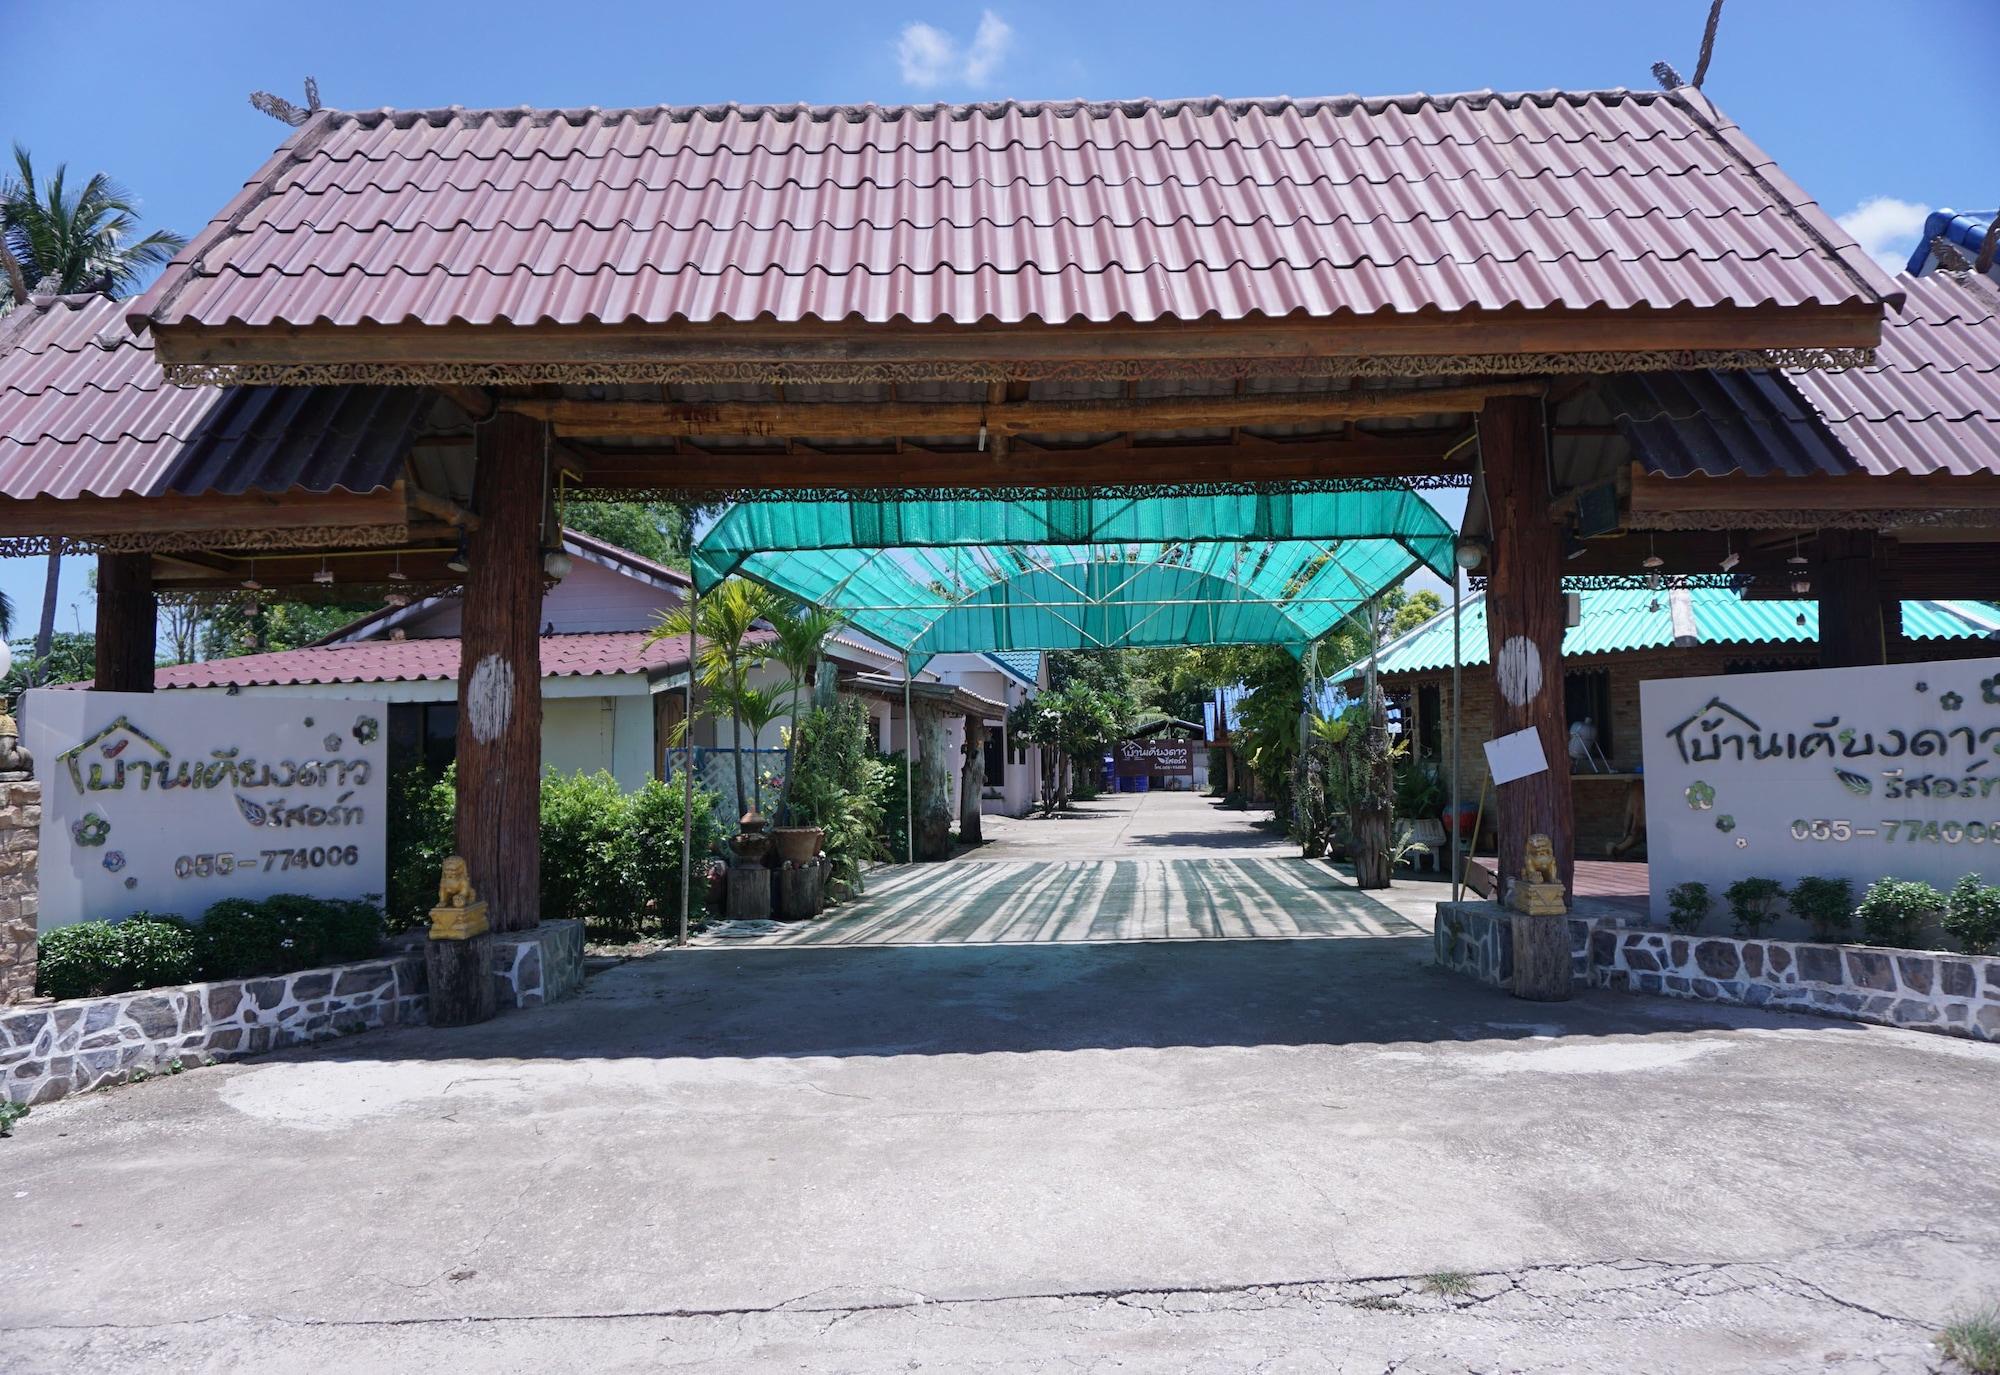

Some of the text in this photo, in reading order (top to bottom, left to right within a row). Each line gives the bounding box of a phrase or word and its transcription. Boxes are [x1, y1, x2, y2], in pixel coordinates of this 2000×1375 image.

[87, 740, 371, 791] บ้านเคียงดาว
[266, 790, 365, 828] รีสอร์ท
[174, 844, 359, 880] 055-774006
